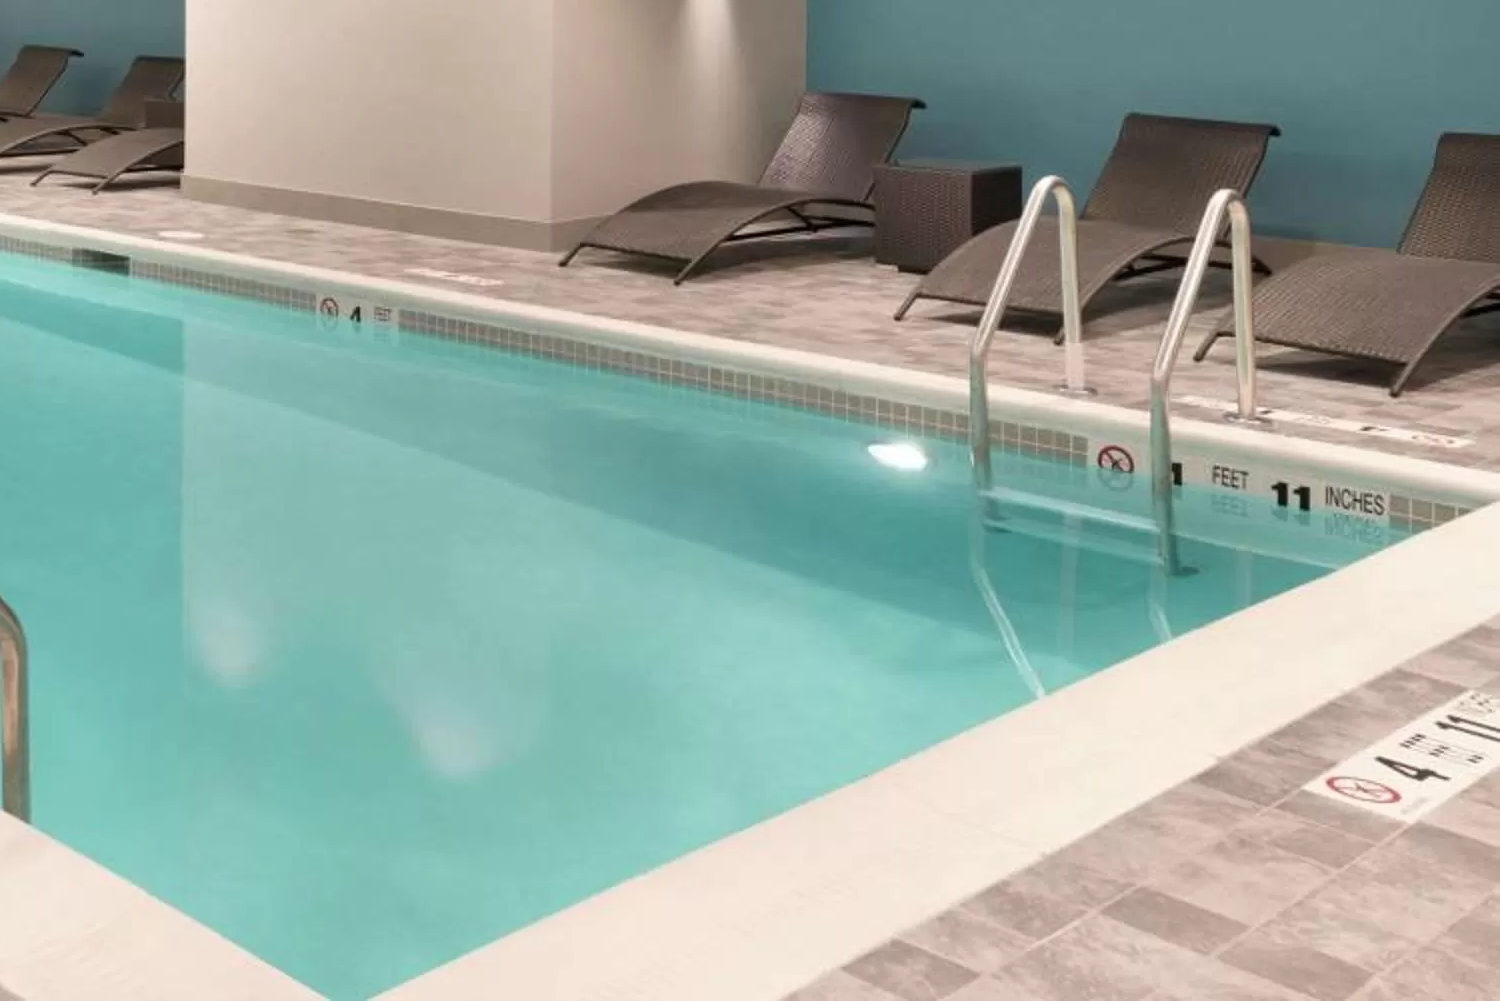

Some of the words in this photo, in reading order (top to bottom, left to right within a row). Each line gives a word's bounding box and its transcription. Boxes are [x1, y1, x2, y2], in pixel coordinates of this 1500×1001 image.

[1211, 464, 1250, 490] FEET
[1271, 481, 1311, 512] 11
[1325, 486, 1386, 516] INCHES
[1374, 755, 1452, 782] 4
